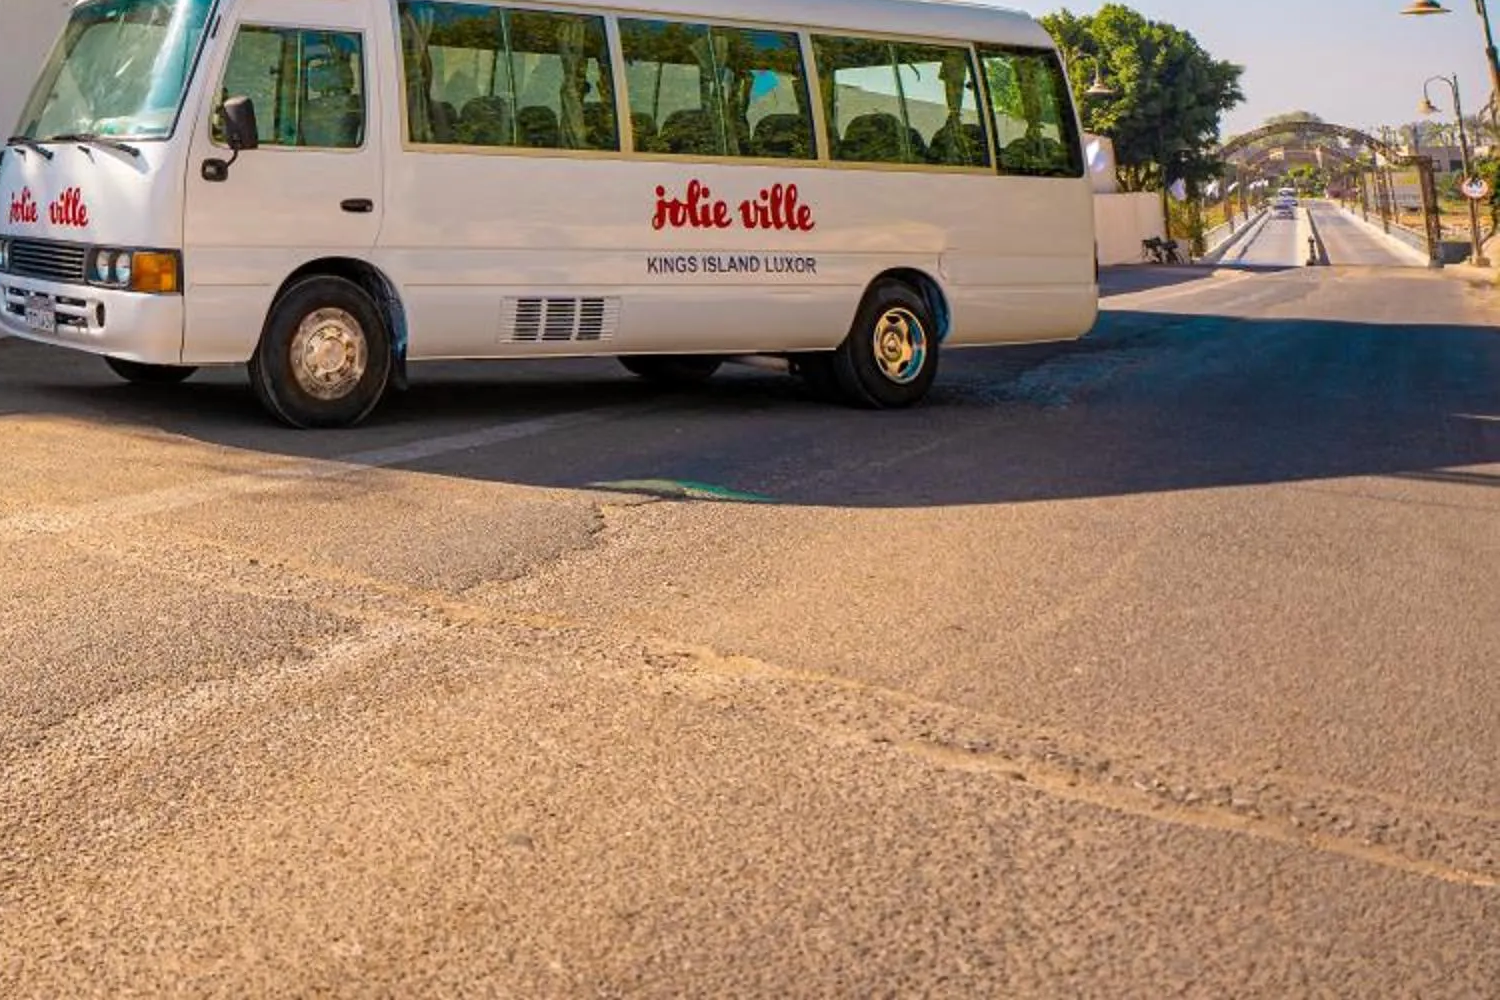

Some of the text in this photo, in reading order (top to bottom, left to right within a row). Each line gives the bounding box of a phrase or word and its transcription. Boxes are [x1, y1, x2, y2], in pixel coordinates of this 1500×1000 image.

[9, 186, 89, 227] jolie ville
[651, 179, 815, 231] jolie ville
[647, 255, 816, 274] KINGS ISLAND LUXOR
